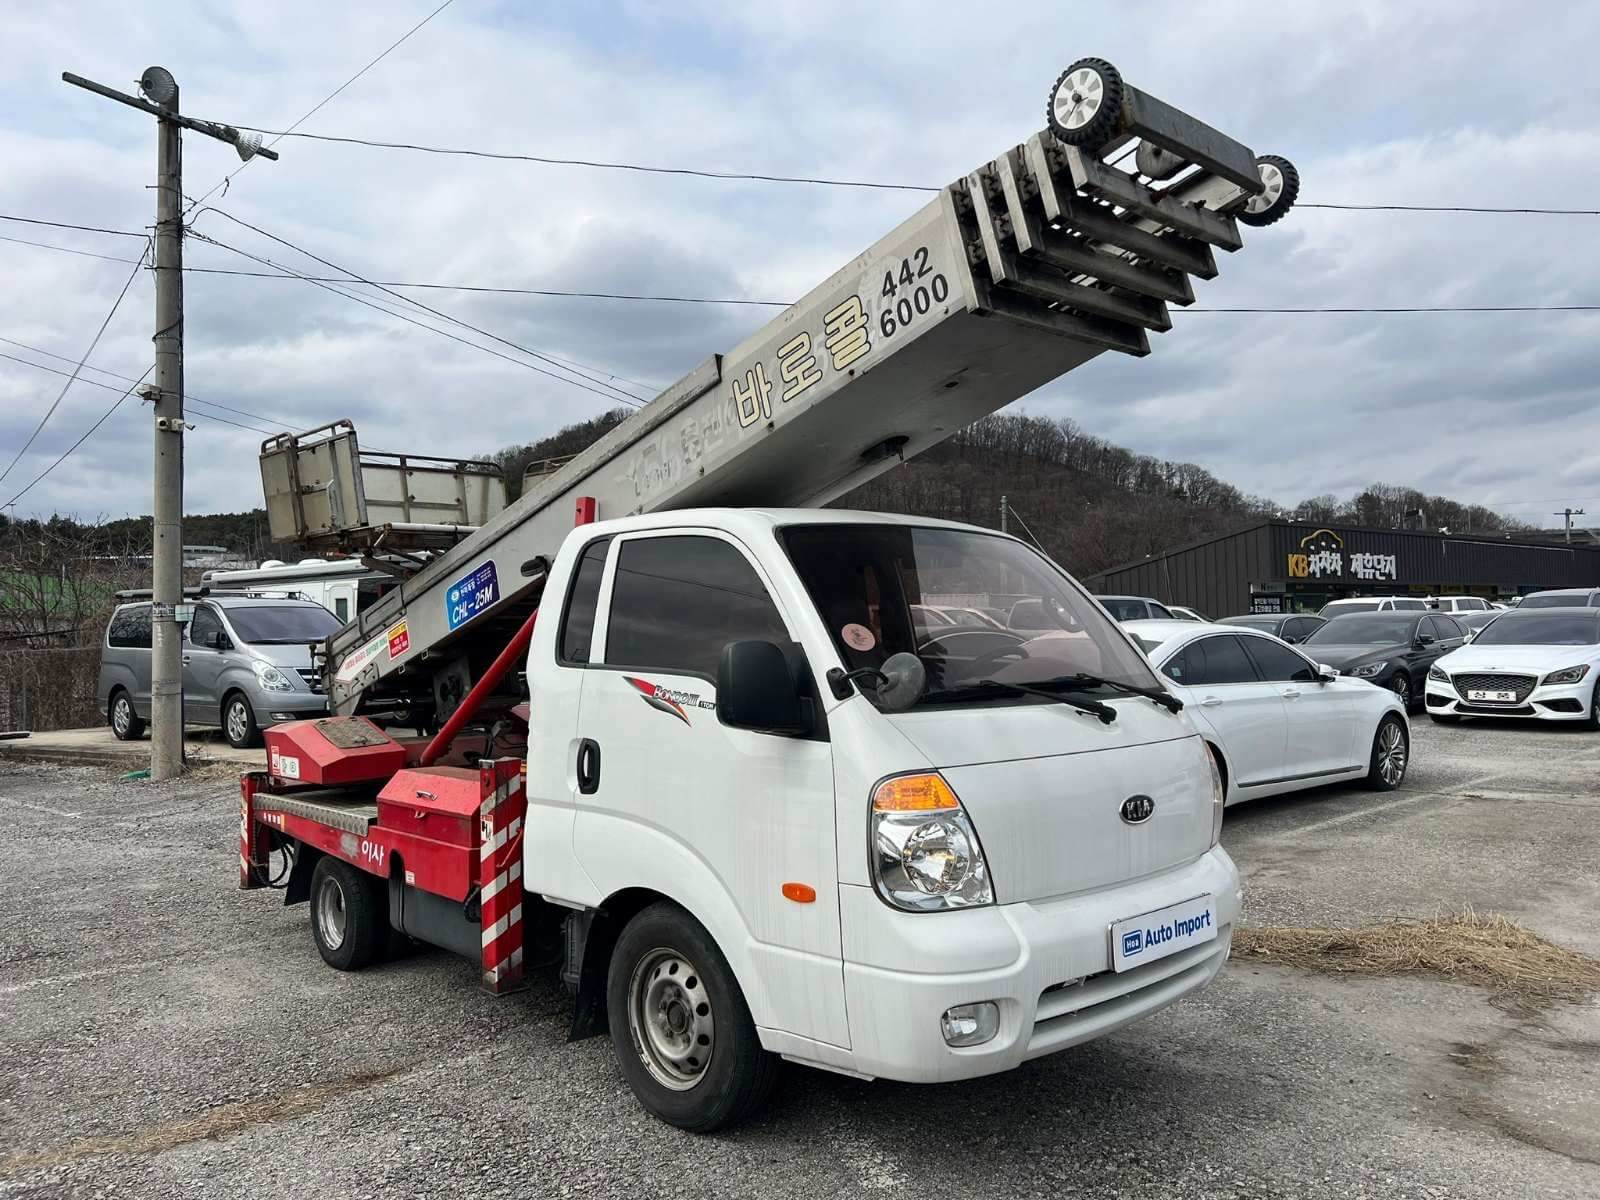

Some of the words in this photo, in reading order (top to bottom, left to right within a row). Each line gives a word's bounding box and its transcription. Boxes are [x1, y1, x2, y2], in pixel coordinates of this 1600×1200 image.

[882, 247, 933, 299] 442
[880, 273, 949, 338] 6000
[732, 294, 871, 428] 바로콜
[362, 840, 384, 866] 이사
[1145, 924, 1172, 948] Auto
[1174, 909, 1211, 938] Import
